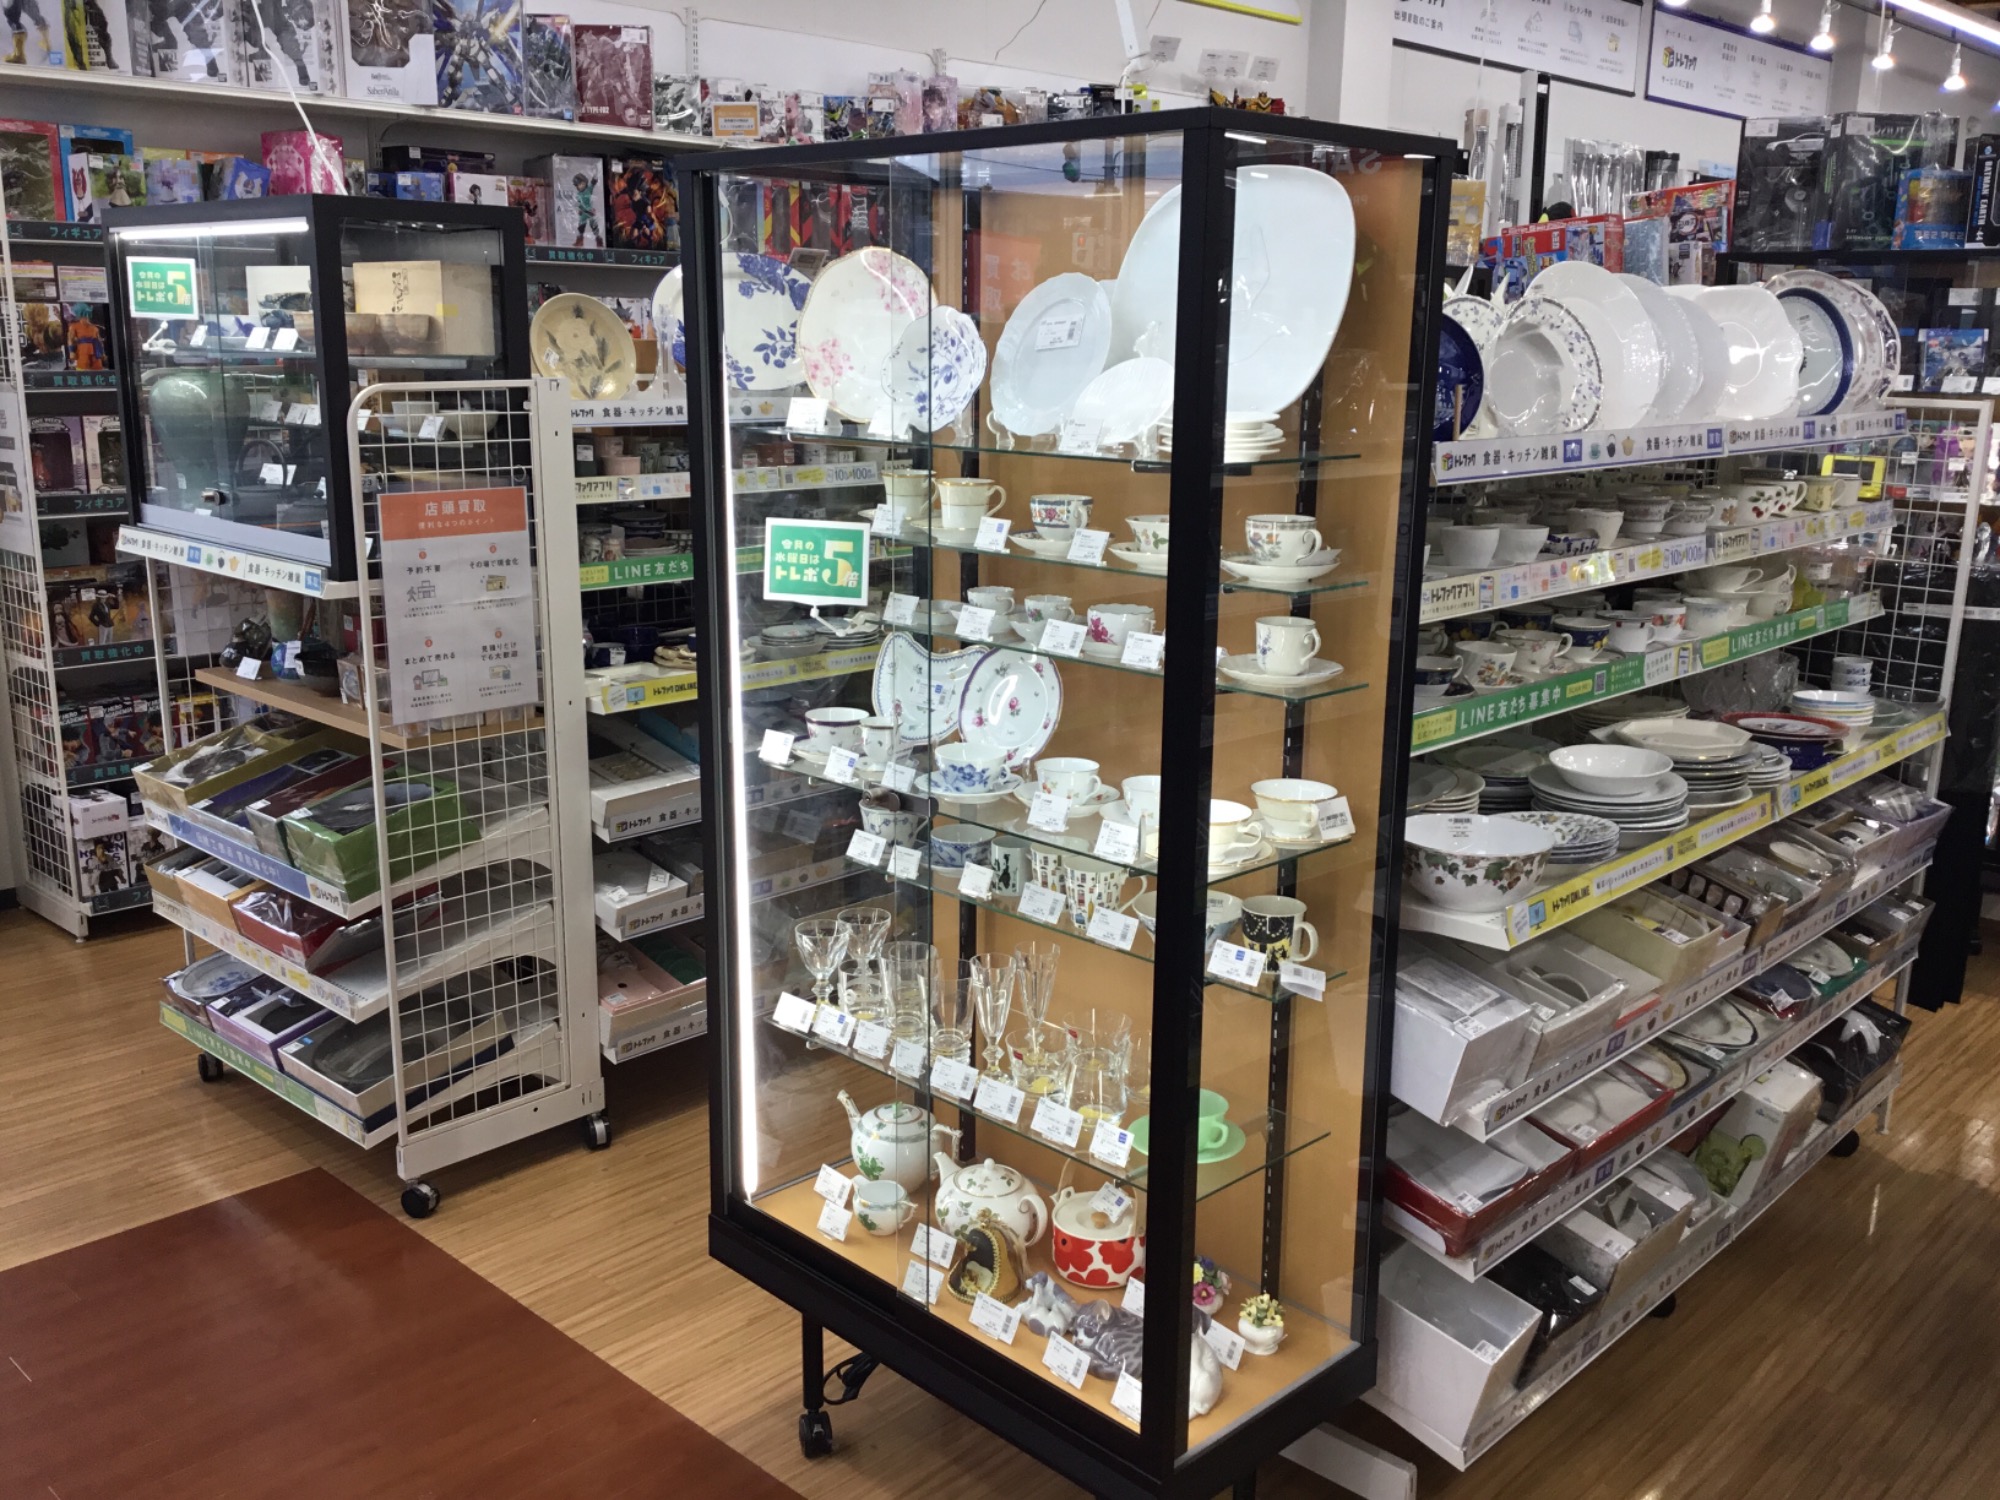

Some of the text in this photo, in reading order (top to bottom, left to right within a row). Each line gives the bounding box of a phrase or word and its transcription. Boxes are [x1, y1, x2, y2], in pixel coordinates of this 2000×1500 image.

[53, 375, 117, 387] 買取強化中
[602, 405, 685, 418] 食器・キッチン雑貨
[1646, 432, 1703, 451] 食器・キッチン雑貨
[1454, 445, 1558, 467] トレファク 食器・キッチン雑貨
[424, 499, 487, 517] 店頭買取
[781, 539, 815, 551] 今月の
[775, 552, 820, 565] 水曜日は
[248, 562, 301, 584] 食器・キッチン雑貨
[406, 564, 441, 575] 予約不要
[614, 559, 690, 580] LINE友だち
[775, 566, 820, 582] トレポ
[80, 646, 144, 662] 買取強化中
[404, 652, 456, 665] まとめて売れる
[1460, 684, 1562, 731] LINE友だち募集中
